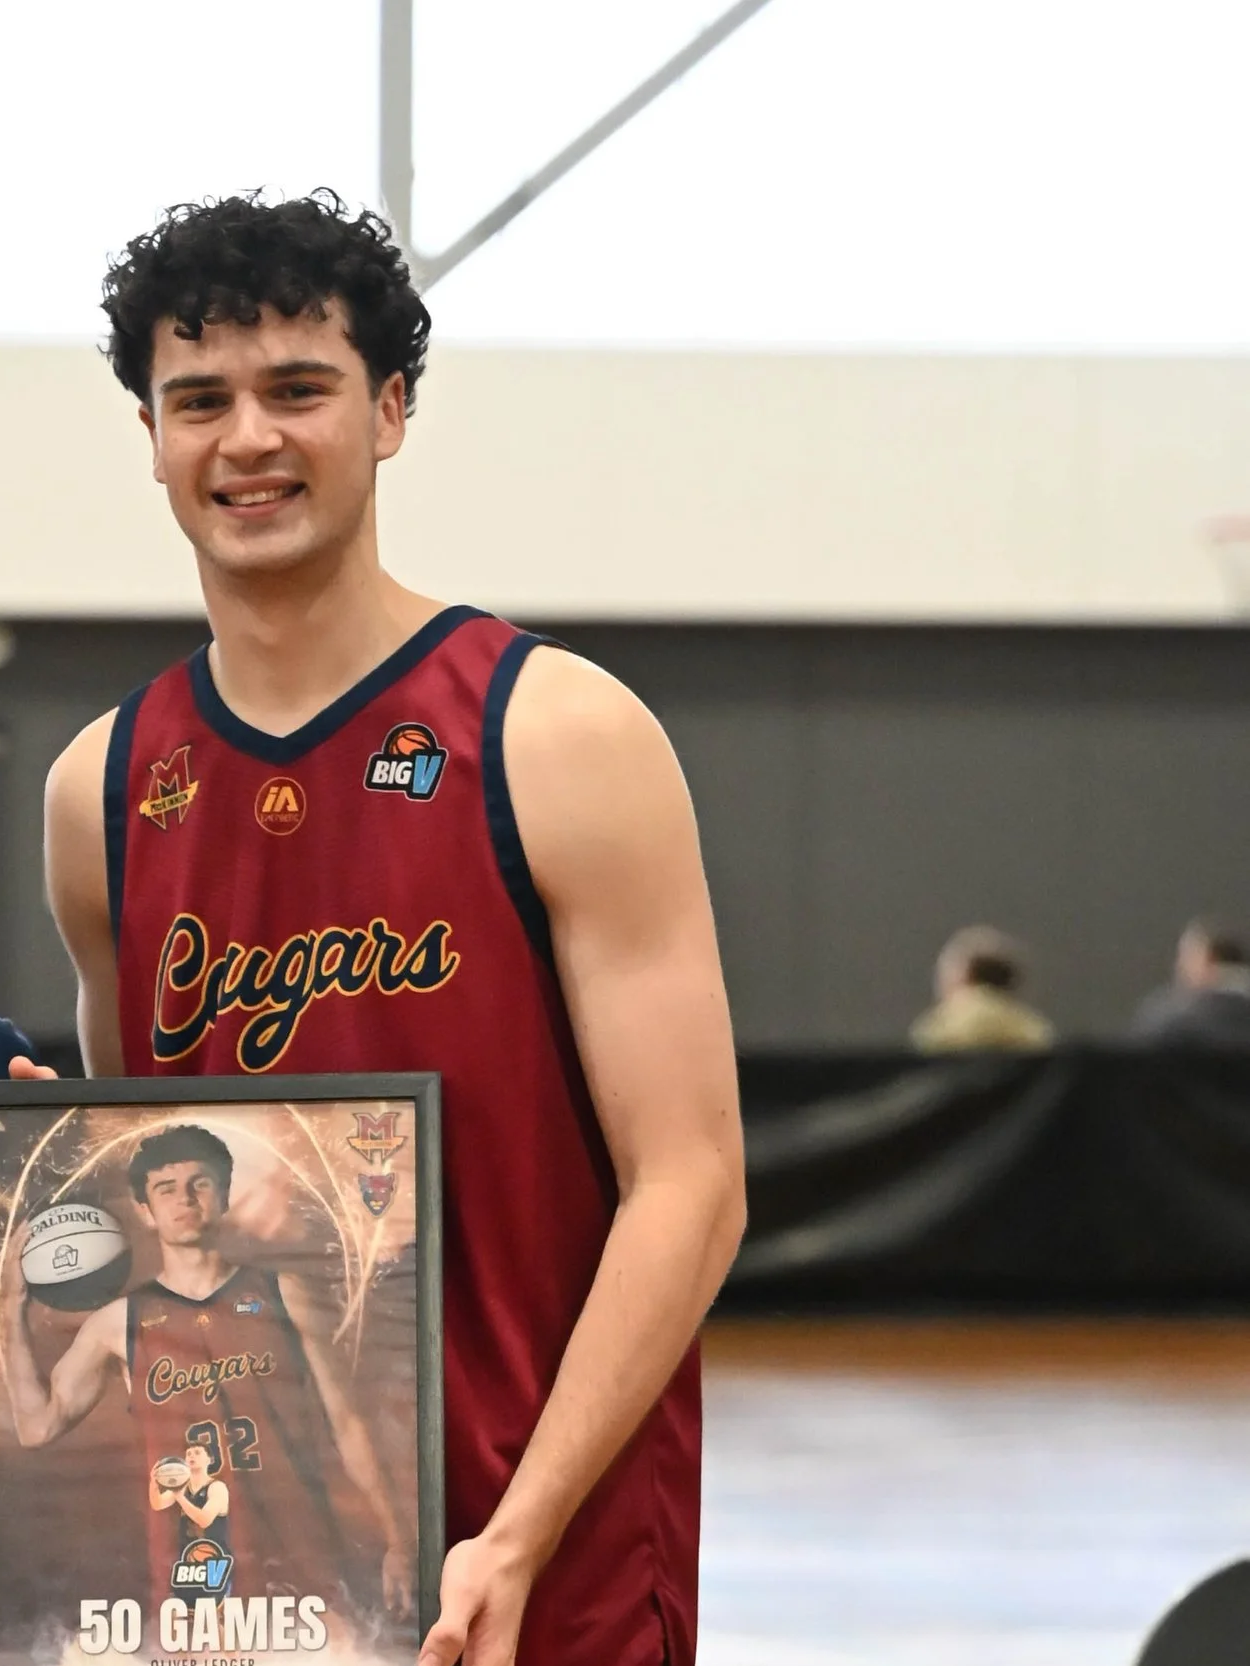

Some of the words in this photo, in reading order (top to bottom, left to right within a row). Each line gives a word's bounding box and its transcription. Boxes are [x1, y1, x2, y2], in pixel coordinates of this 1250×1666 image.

[371, 760, 413, 785] BIG
[412, 754, 442, 795] V
[29, 1210, 103, 1238] PALDING
[146, 1351, 276, 1405] Cougars
[176, 1565, 207, 1583] BIG
[206, 1559, 229, 1588] V
[78, 1598, 143, 1655] 50
[159, 1595, 328, 1653] GAMES
